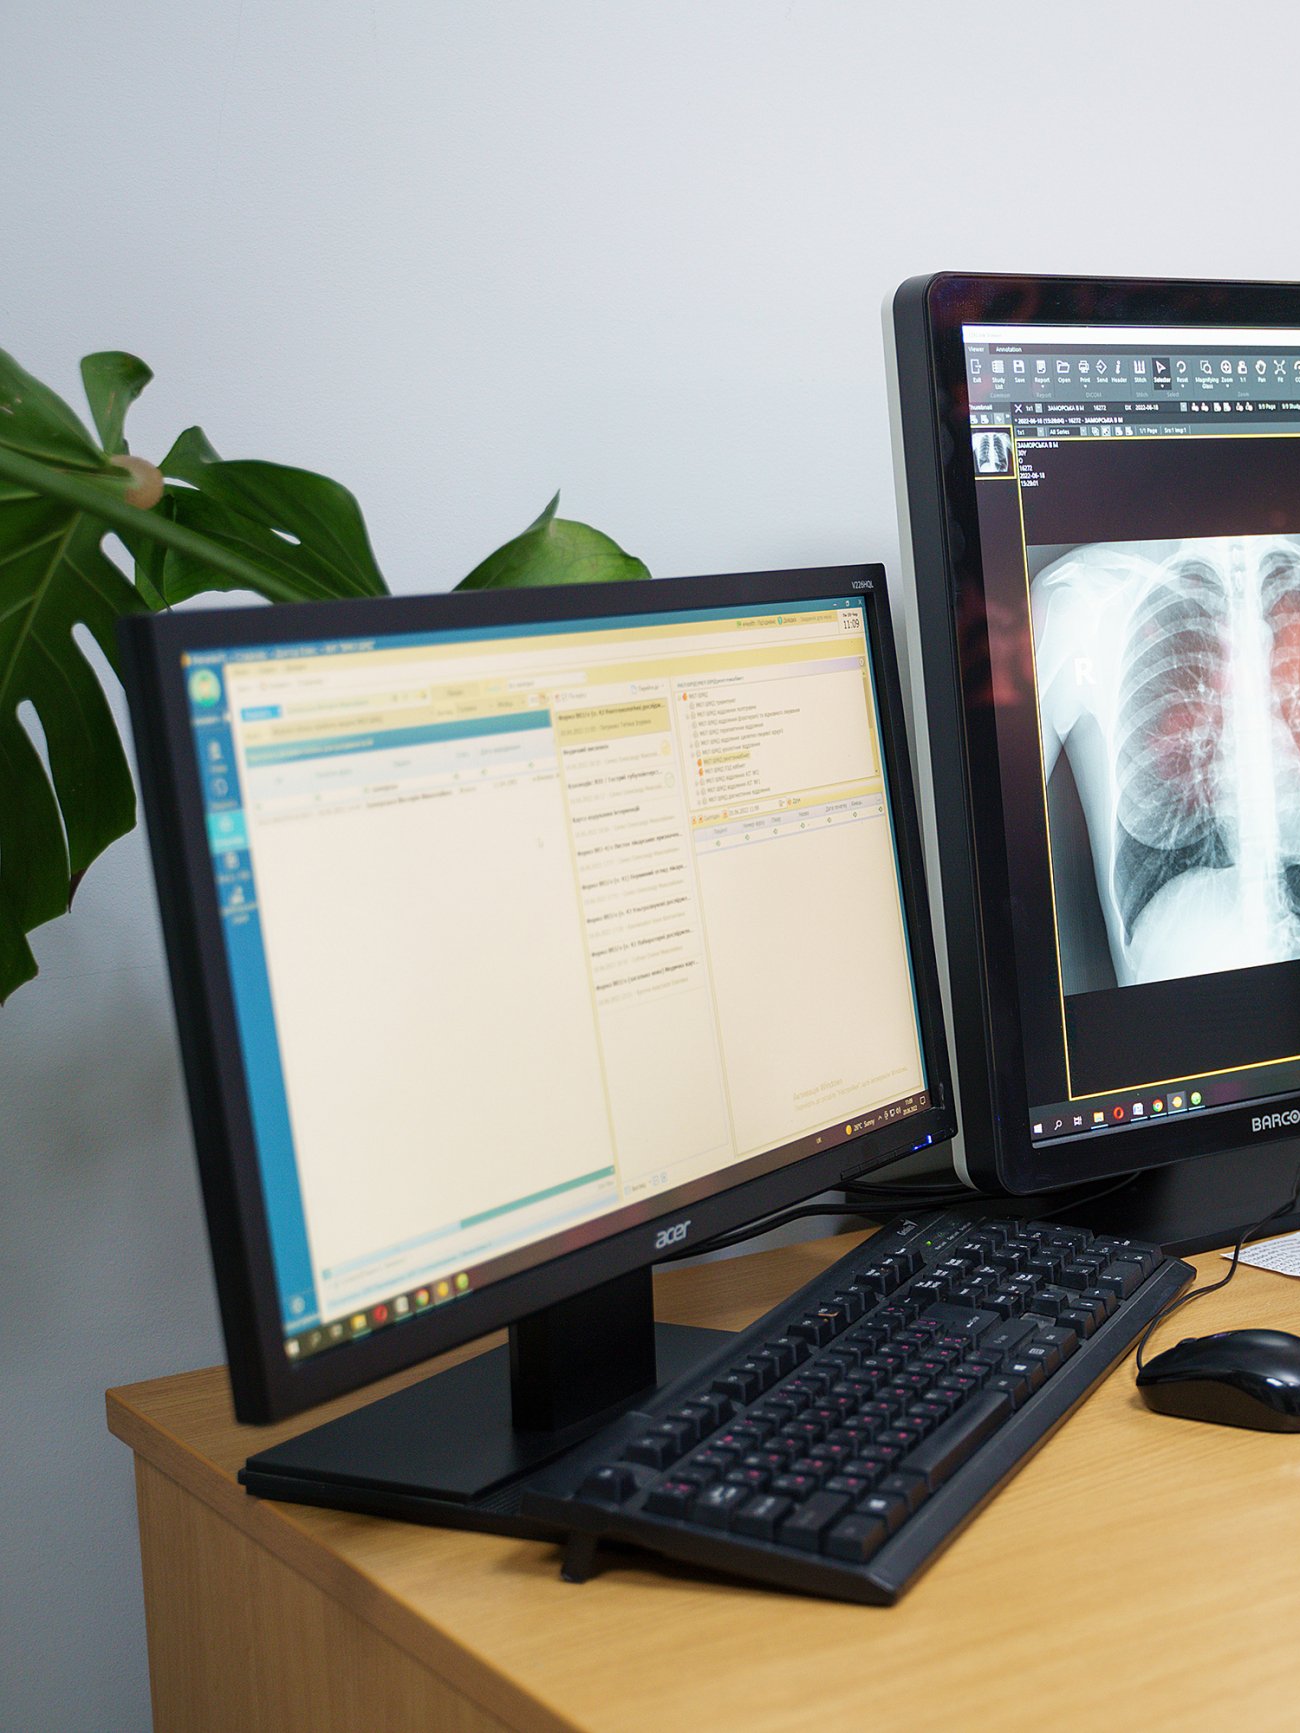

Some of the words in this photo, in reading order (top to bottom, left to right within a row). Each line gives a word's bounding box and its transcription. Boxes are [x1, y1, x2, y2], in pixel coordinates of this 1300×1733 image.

[844, 619, 860, 629] 11:09
[1075, 658, 1096, 686] R
[864, 1119, 876, 1129] Sunny
[656, 1220, 691, 1248] acer
